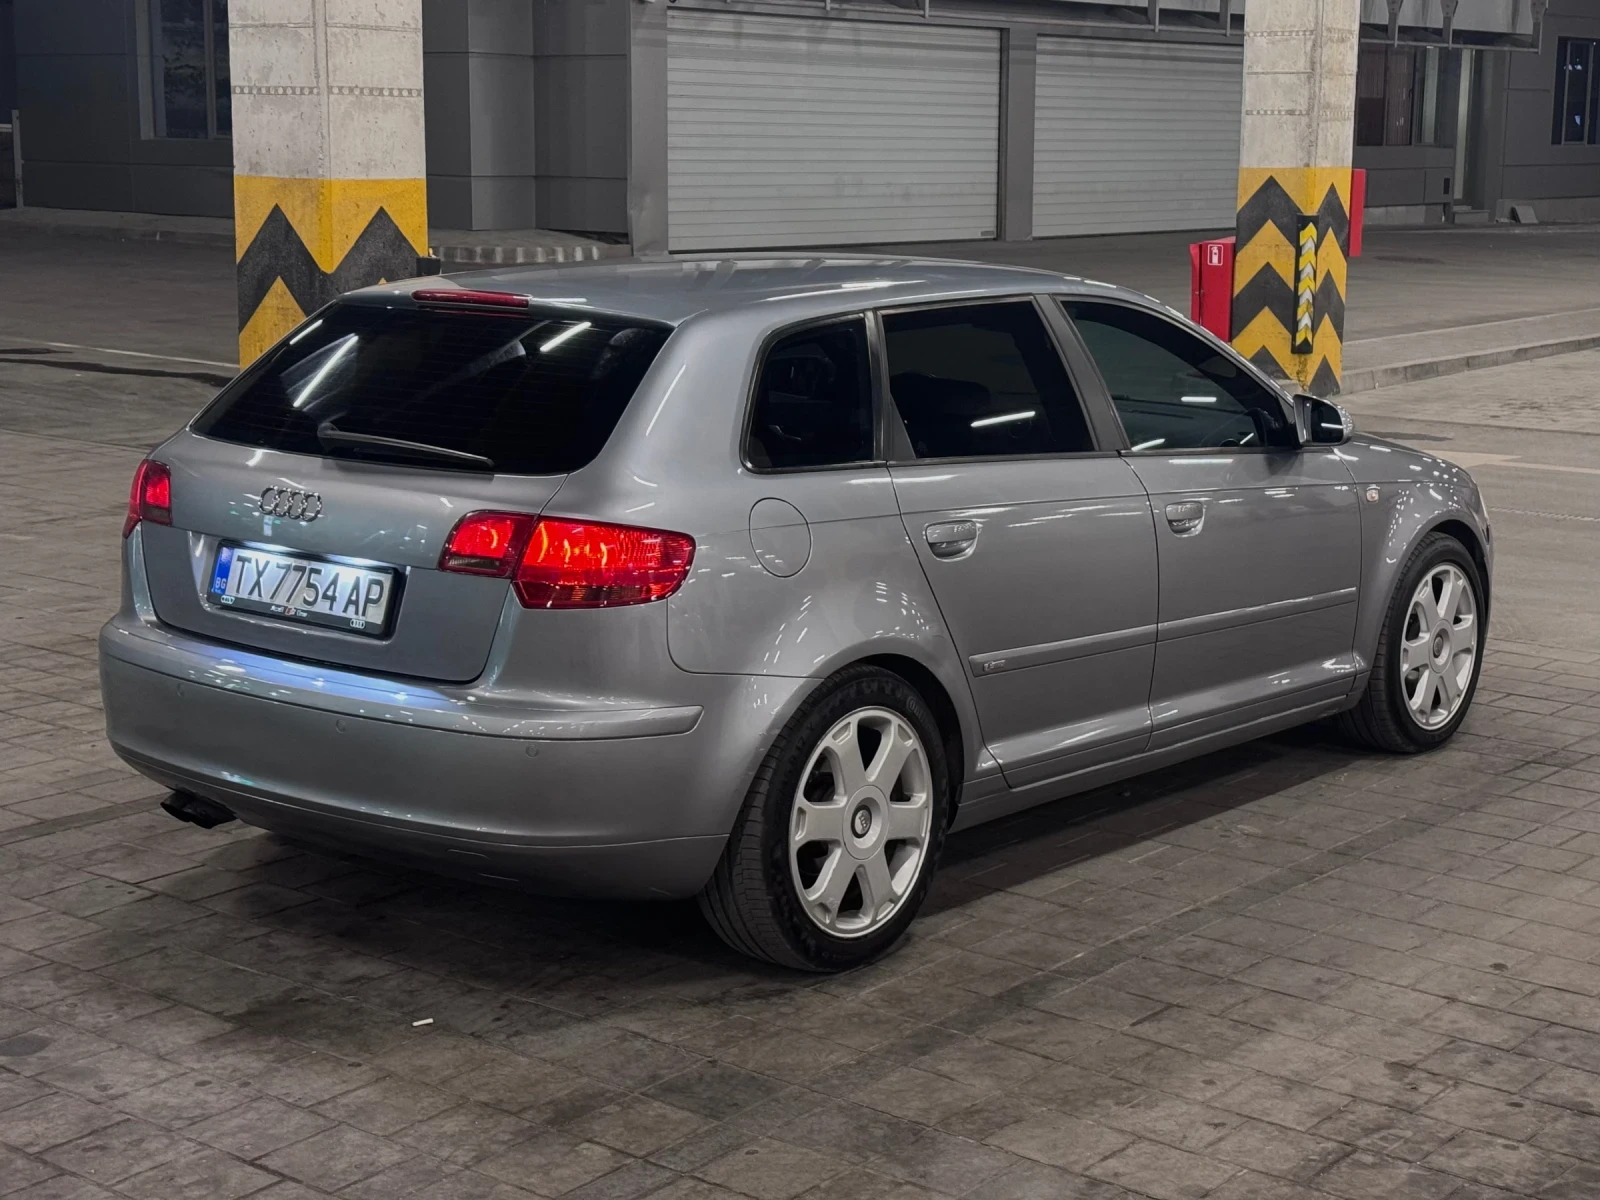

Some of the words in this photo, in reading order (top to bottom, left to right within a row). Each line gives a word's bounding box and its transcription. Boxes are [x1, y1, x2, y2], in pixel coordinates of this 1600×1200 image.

[215, 577, 227, 590] BG
[235, 555, 270, 598] TX
[270, 563, 340, 611] 7754
[342, 575, 385, 617] AP
